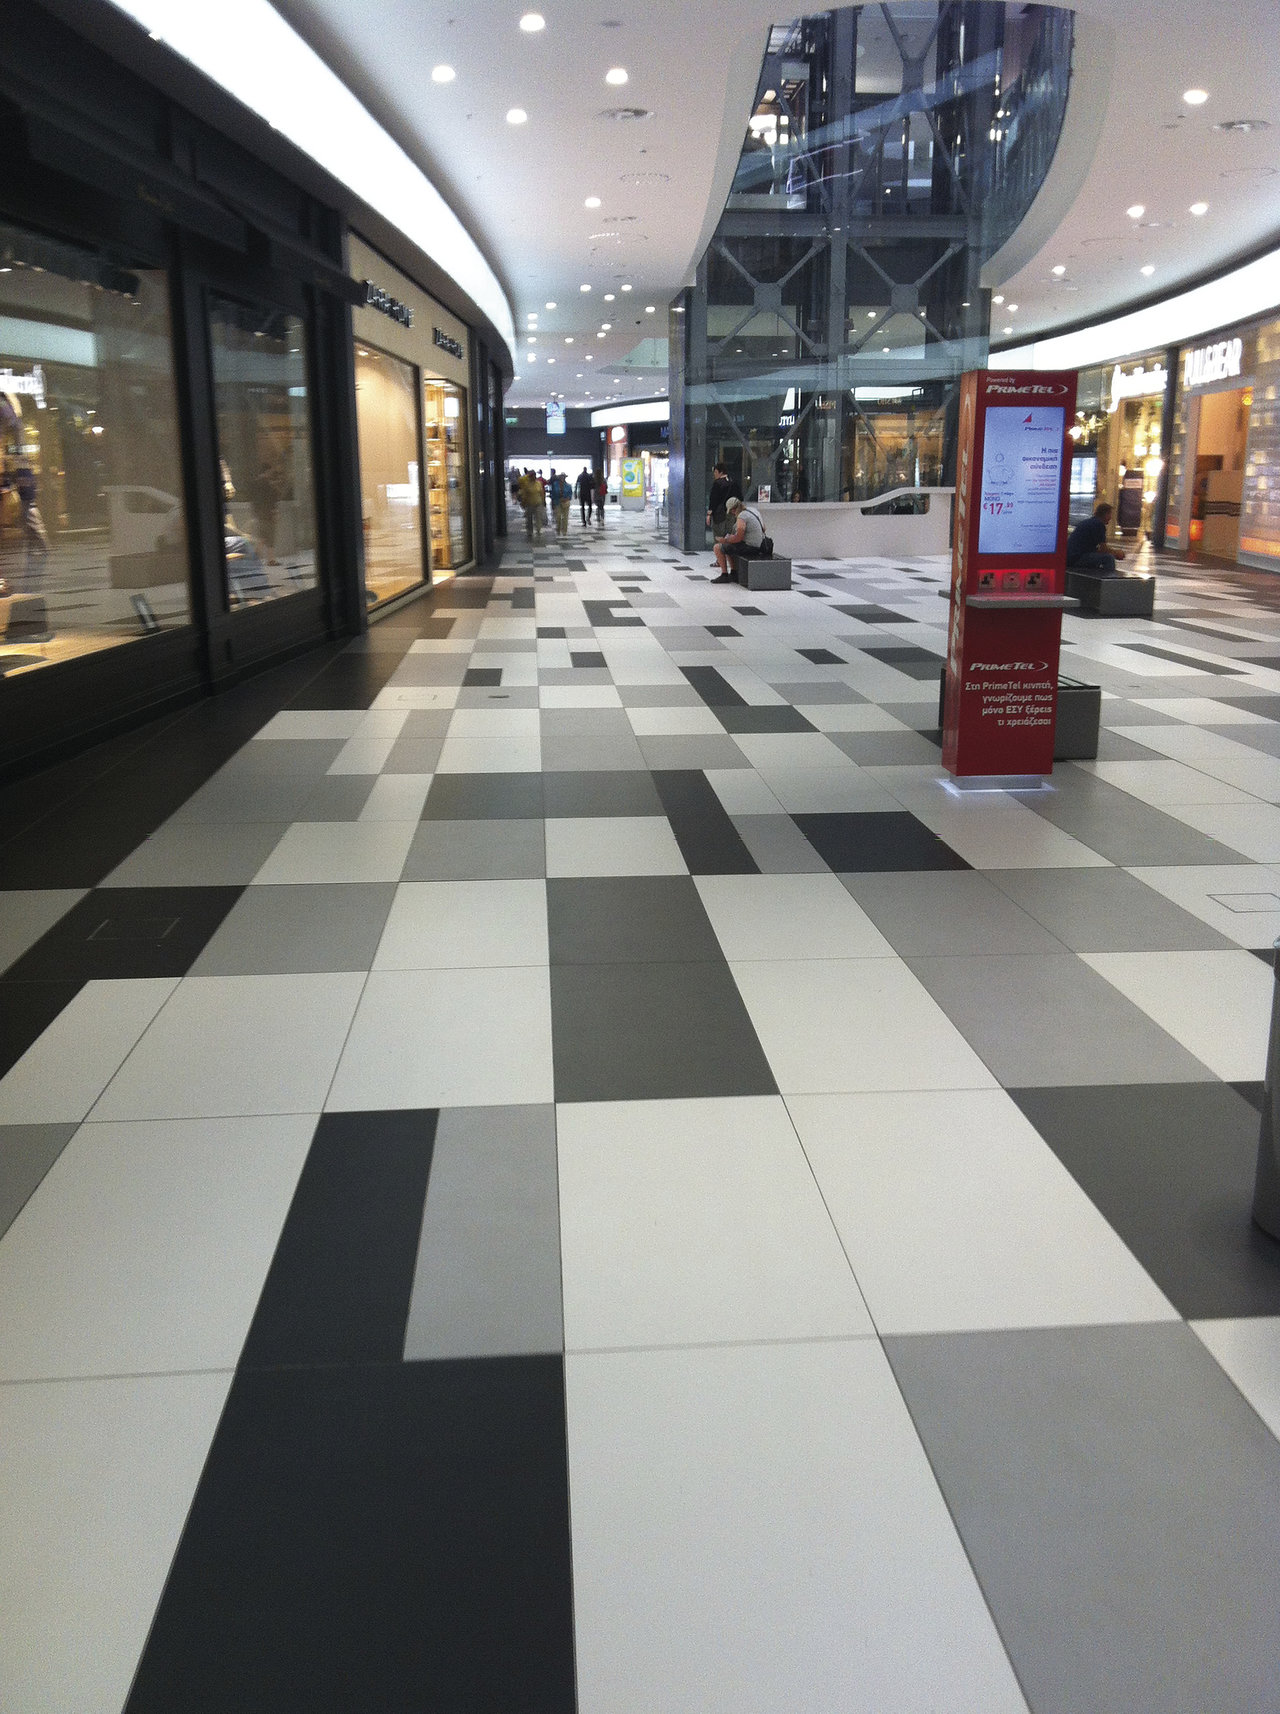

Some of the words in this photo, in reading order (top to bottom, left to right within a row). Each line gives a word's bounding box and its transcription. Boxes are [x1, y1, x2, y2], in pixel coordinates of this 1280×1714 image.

[965, 682, 981, 691] Στη
[982, 681, 1021, 690] PrimeTel
[982, 693, 1032, 704] γνωρίζουμε
[1034, 694, 1053, 702] πως
[982, 705, 1004, 716] μόνο
[1006, 705, 1024, 714] ΕΣΥ
[1025, 704, 1053, 715] ξέρεις
[1006, 718, 1052, 728] χρειάζεσαι
